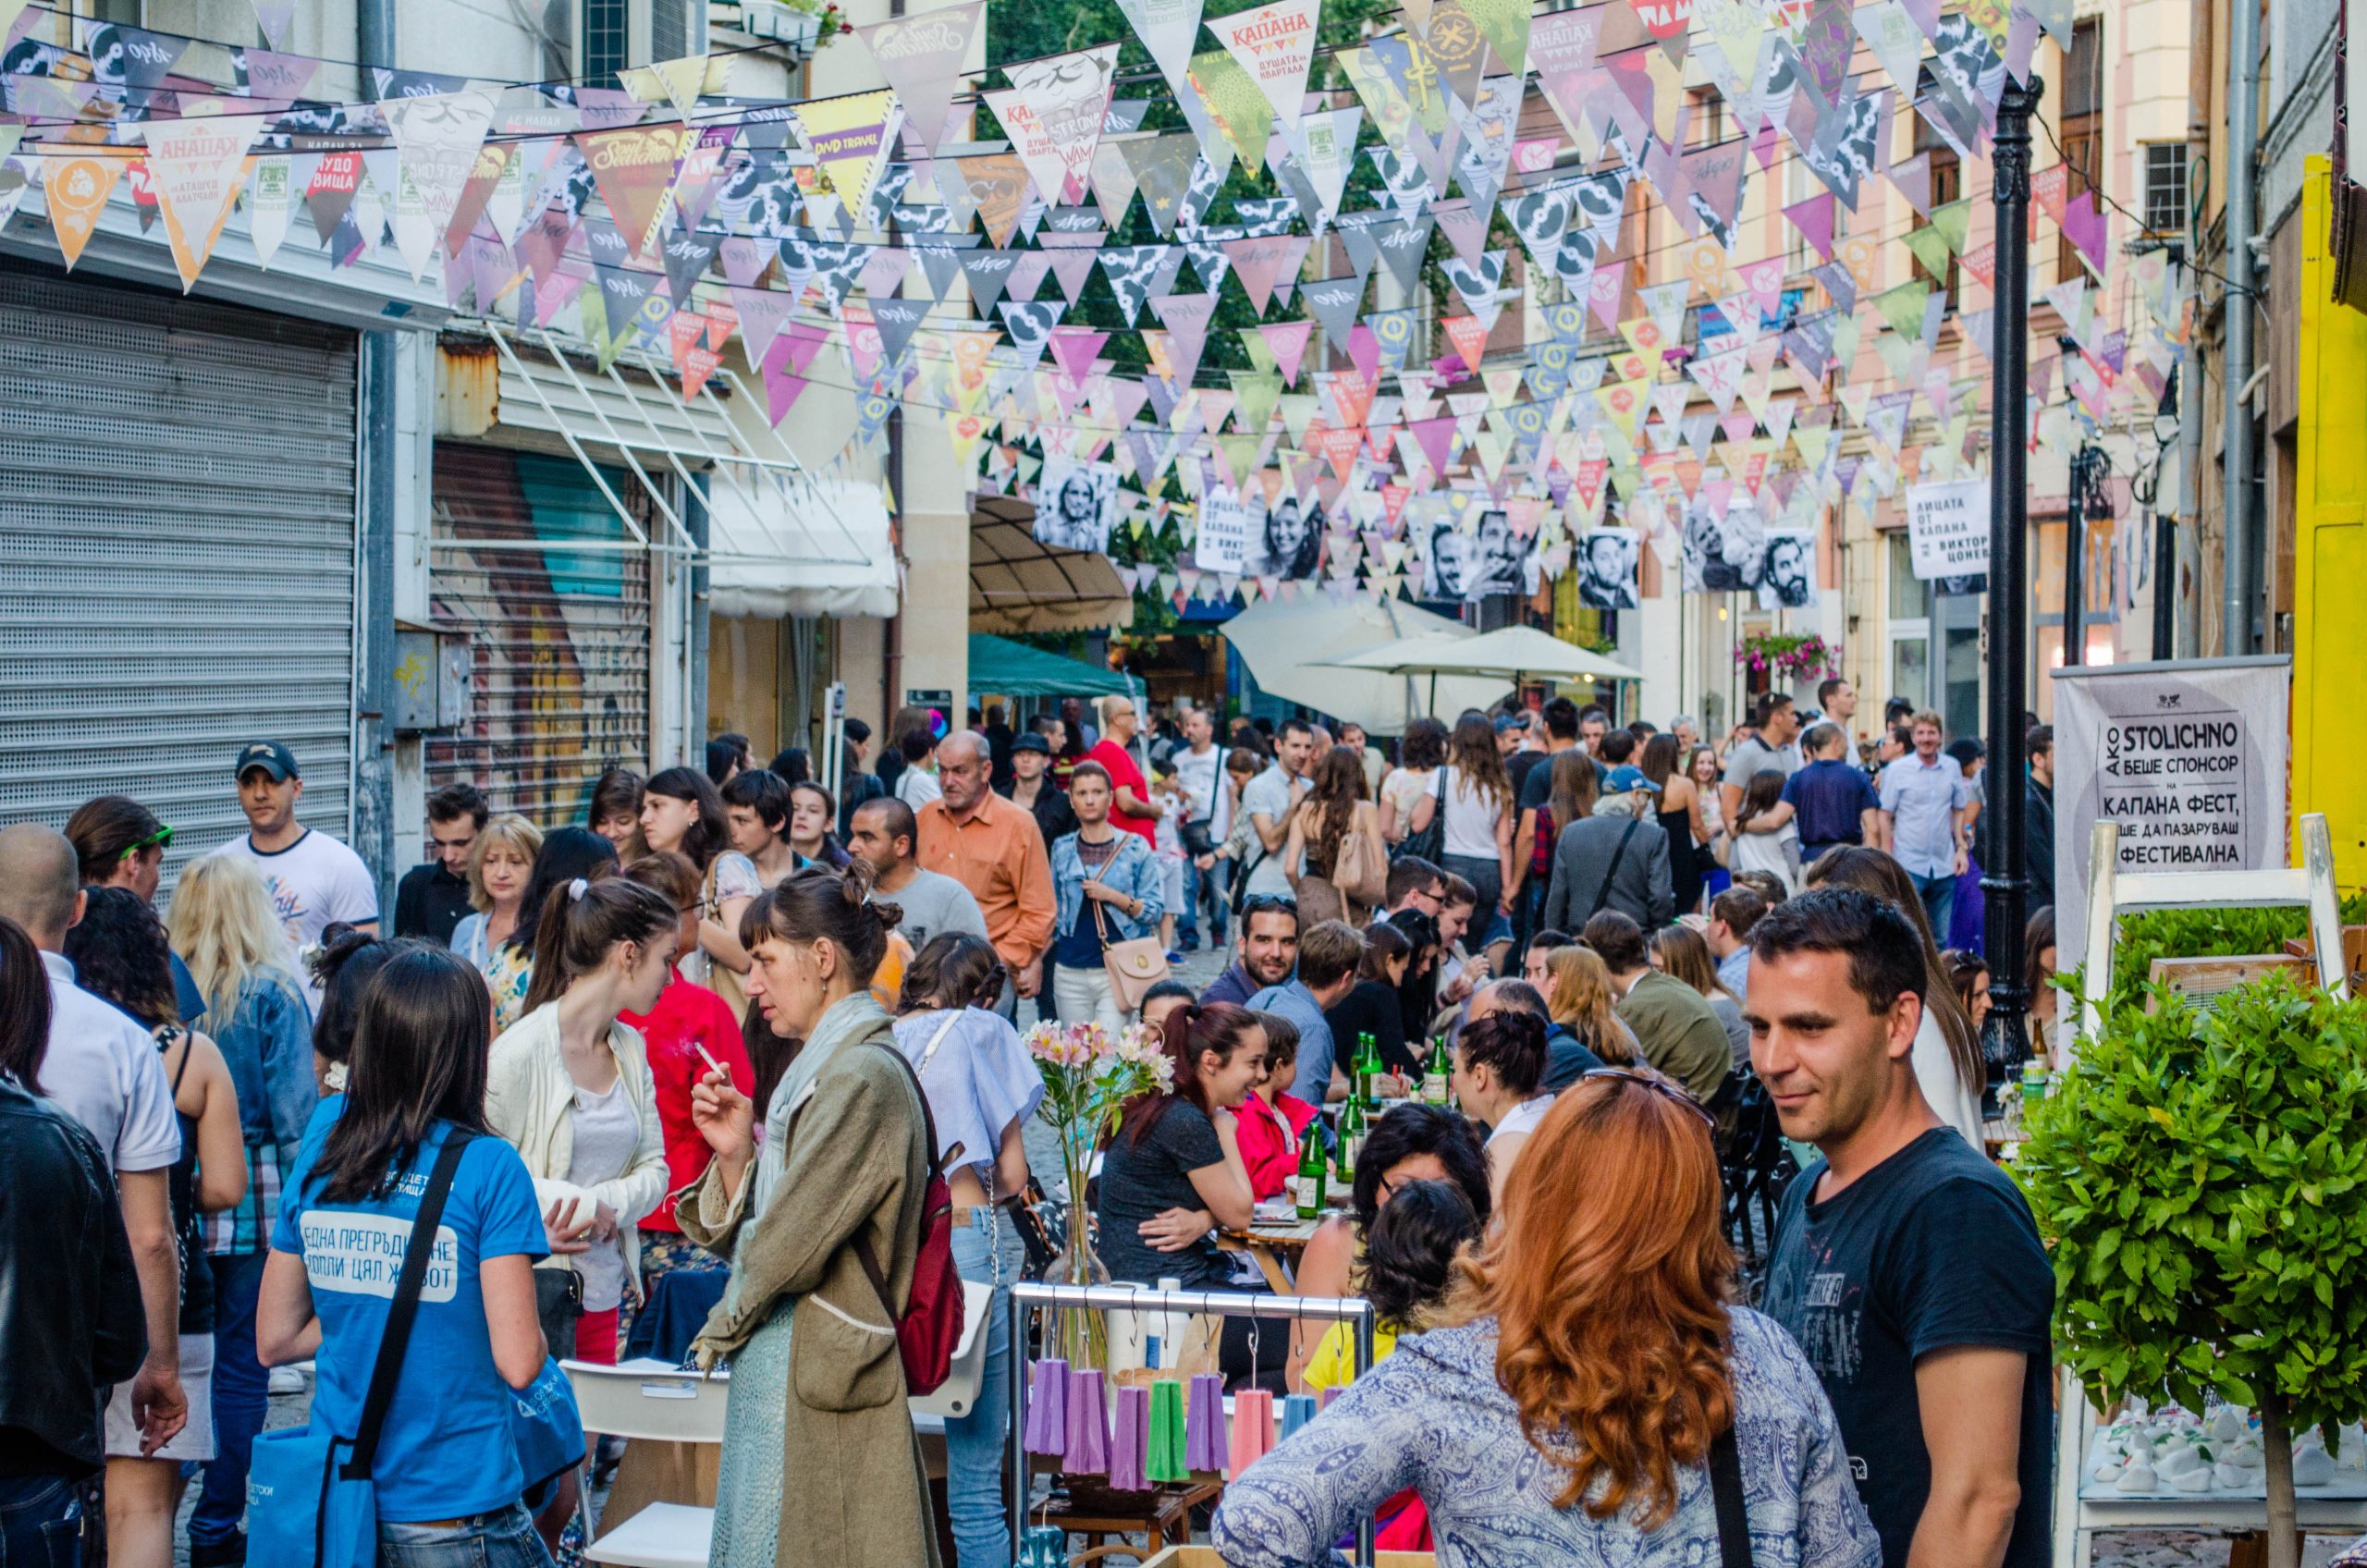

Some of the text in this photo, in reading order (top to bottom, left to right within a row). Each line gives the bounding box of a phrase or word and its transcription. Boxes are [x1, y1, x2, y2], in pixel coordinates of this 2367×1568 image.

[1232, 13, 1311, 46] КАПАНА
[843, 133, 877, 150] TRAVEL
[313, 172, 354, 190] ВИЩА
[1054, 214, 1098, 231] 1890
[1380, 228, 1425, 249] 1890
[666, 240, 711, 260] 1890
[966, 256, 1012, 272] 1890
[1917, 497, 1965, 512] ЛИЦАТА
[1205, 521, 1244, 535] КАПАНА
[1918, 513, 1932, 525] ОТ
[1919, 521, 1968, 536] КАПАНА
[1939, 536, 1988, 551] ВИКТОР
[1947, 548, 1990, 563] ЦОНЕВ
[2124, 722, 2238, 753] STOLICHNO
[2106, 728, 2120, 776] АКО
[2124, 755, 2238, 775] БЕШЕ СПОНСОР
[2103, 793, 2239, 817] КАПАНА ФЕСТ,
[2142, 823, 2162, 838] ДА
[2165, 821, 2238, 837] ПАЗАРУВАШ
[2120, 844, 2239, 864] ФЕСТИВАЛНА
[303, 1227, 335, 1250] ЕДНА
[351, 1258, 382, 1282] ЦЯЛ
